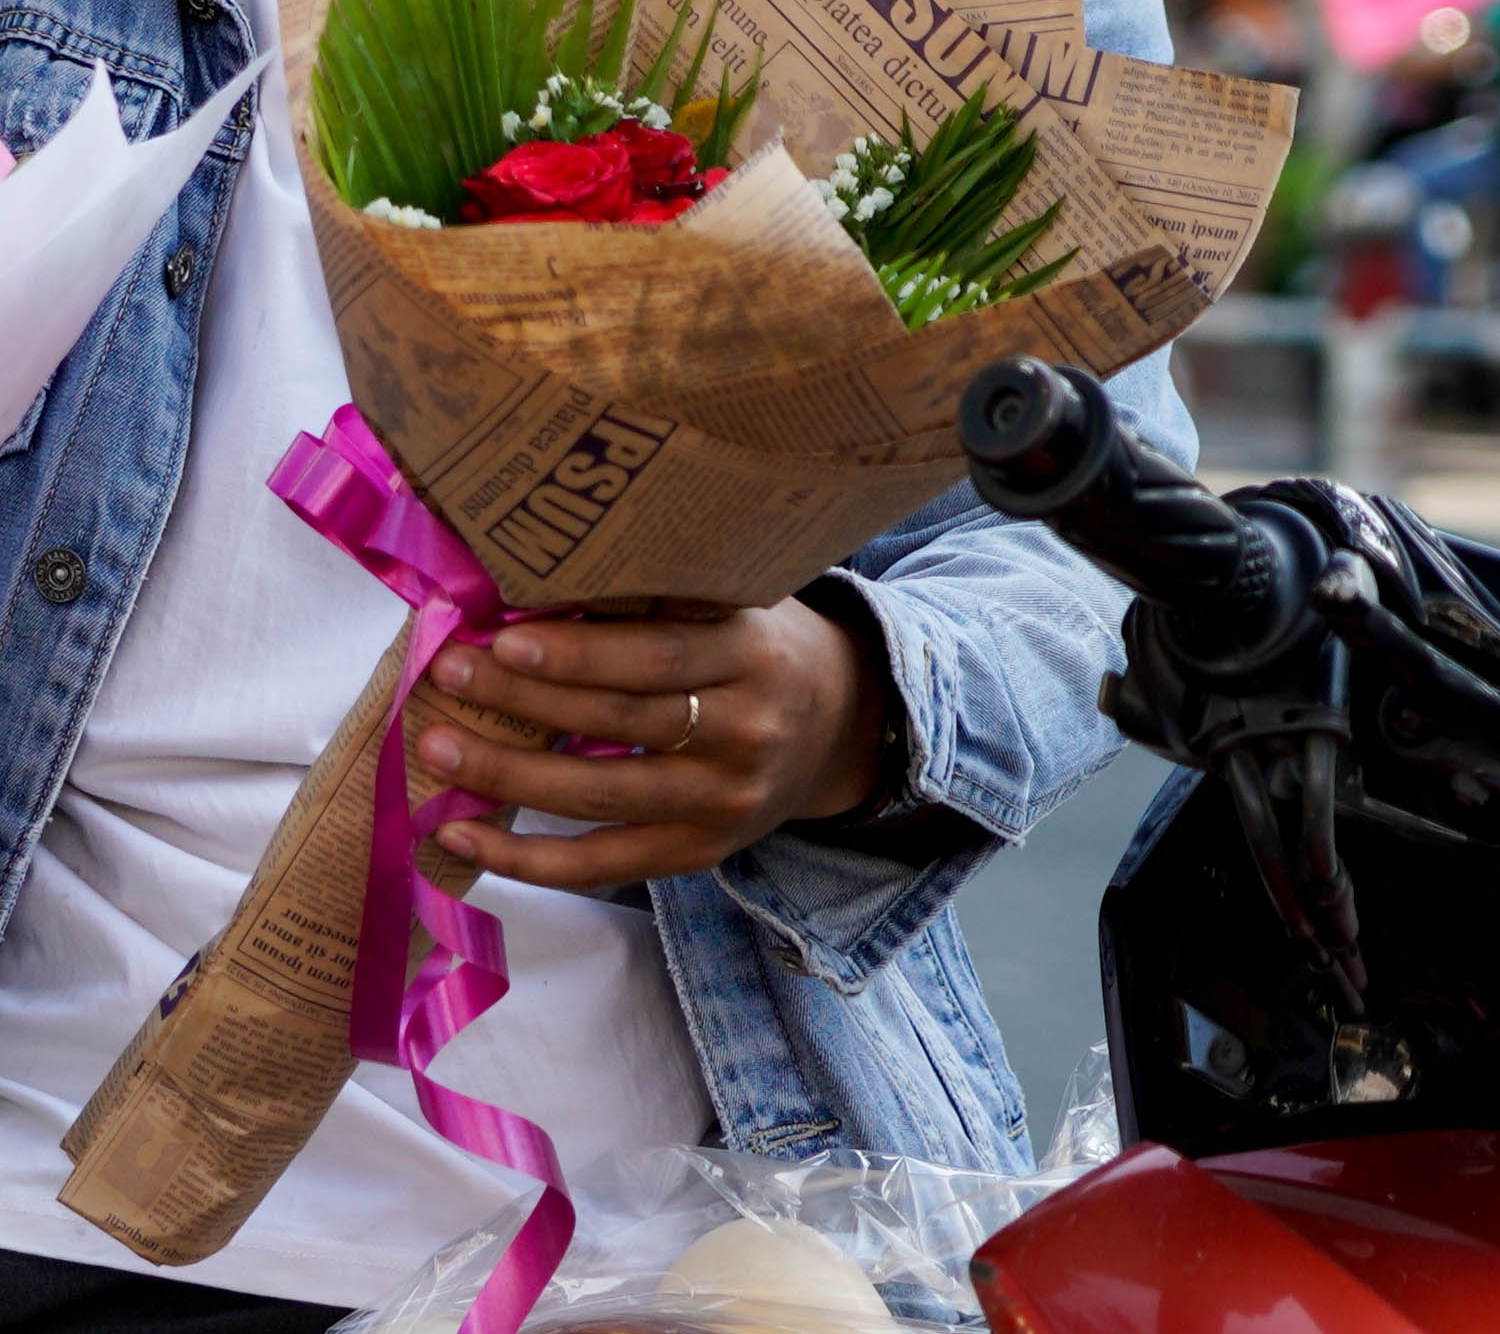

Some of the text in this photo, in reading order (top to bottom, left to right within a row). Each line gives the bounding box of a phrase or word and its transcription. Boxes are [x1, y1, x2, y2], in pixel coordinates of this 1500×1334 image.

[710, 31, 748, 74] elit
[883, 55, 948, 122] dictu
[1143, 212, 1239, 243] orem ipsum
[1192, 245, 1232, 263] amet
[528, 383, 594, 453] platea
[486, 405, 678, 578] IPSUM
[260, 918, 357, 972] lor sit amet
[281, 908, 359, 948] nsectetur
[250, 935, 351, 990] orem ipsum
[100, 1211, 161, 1253] torquent
